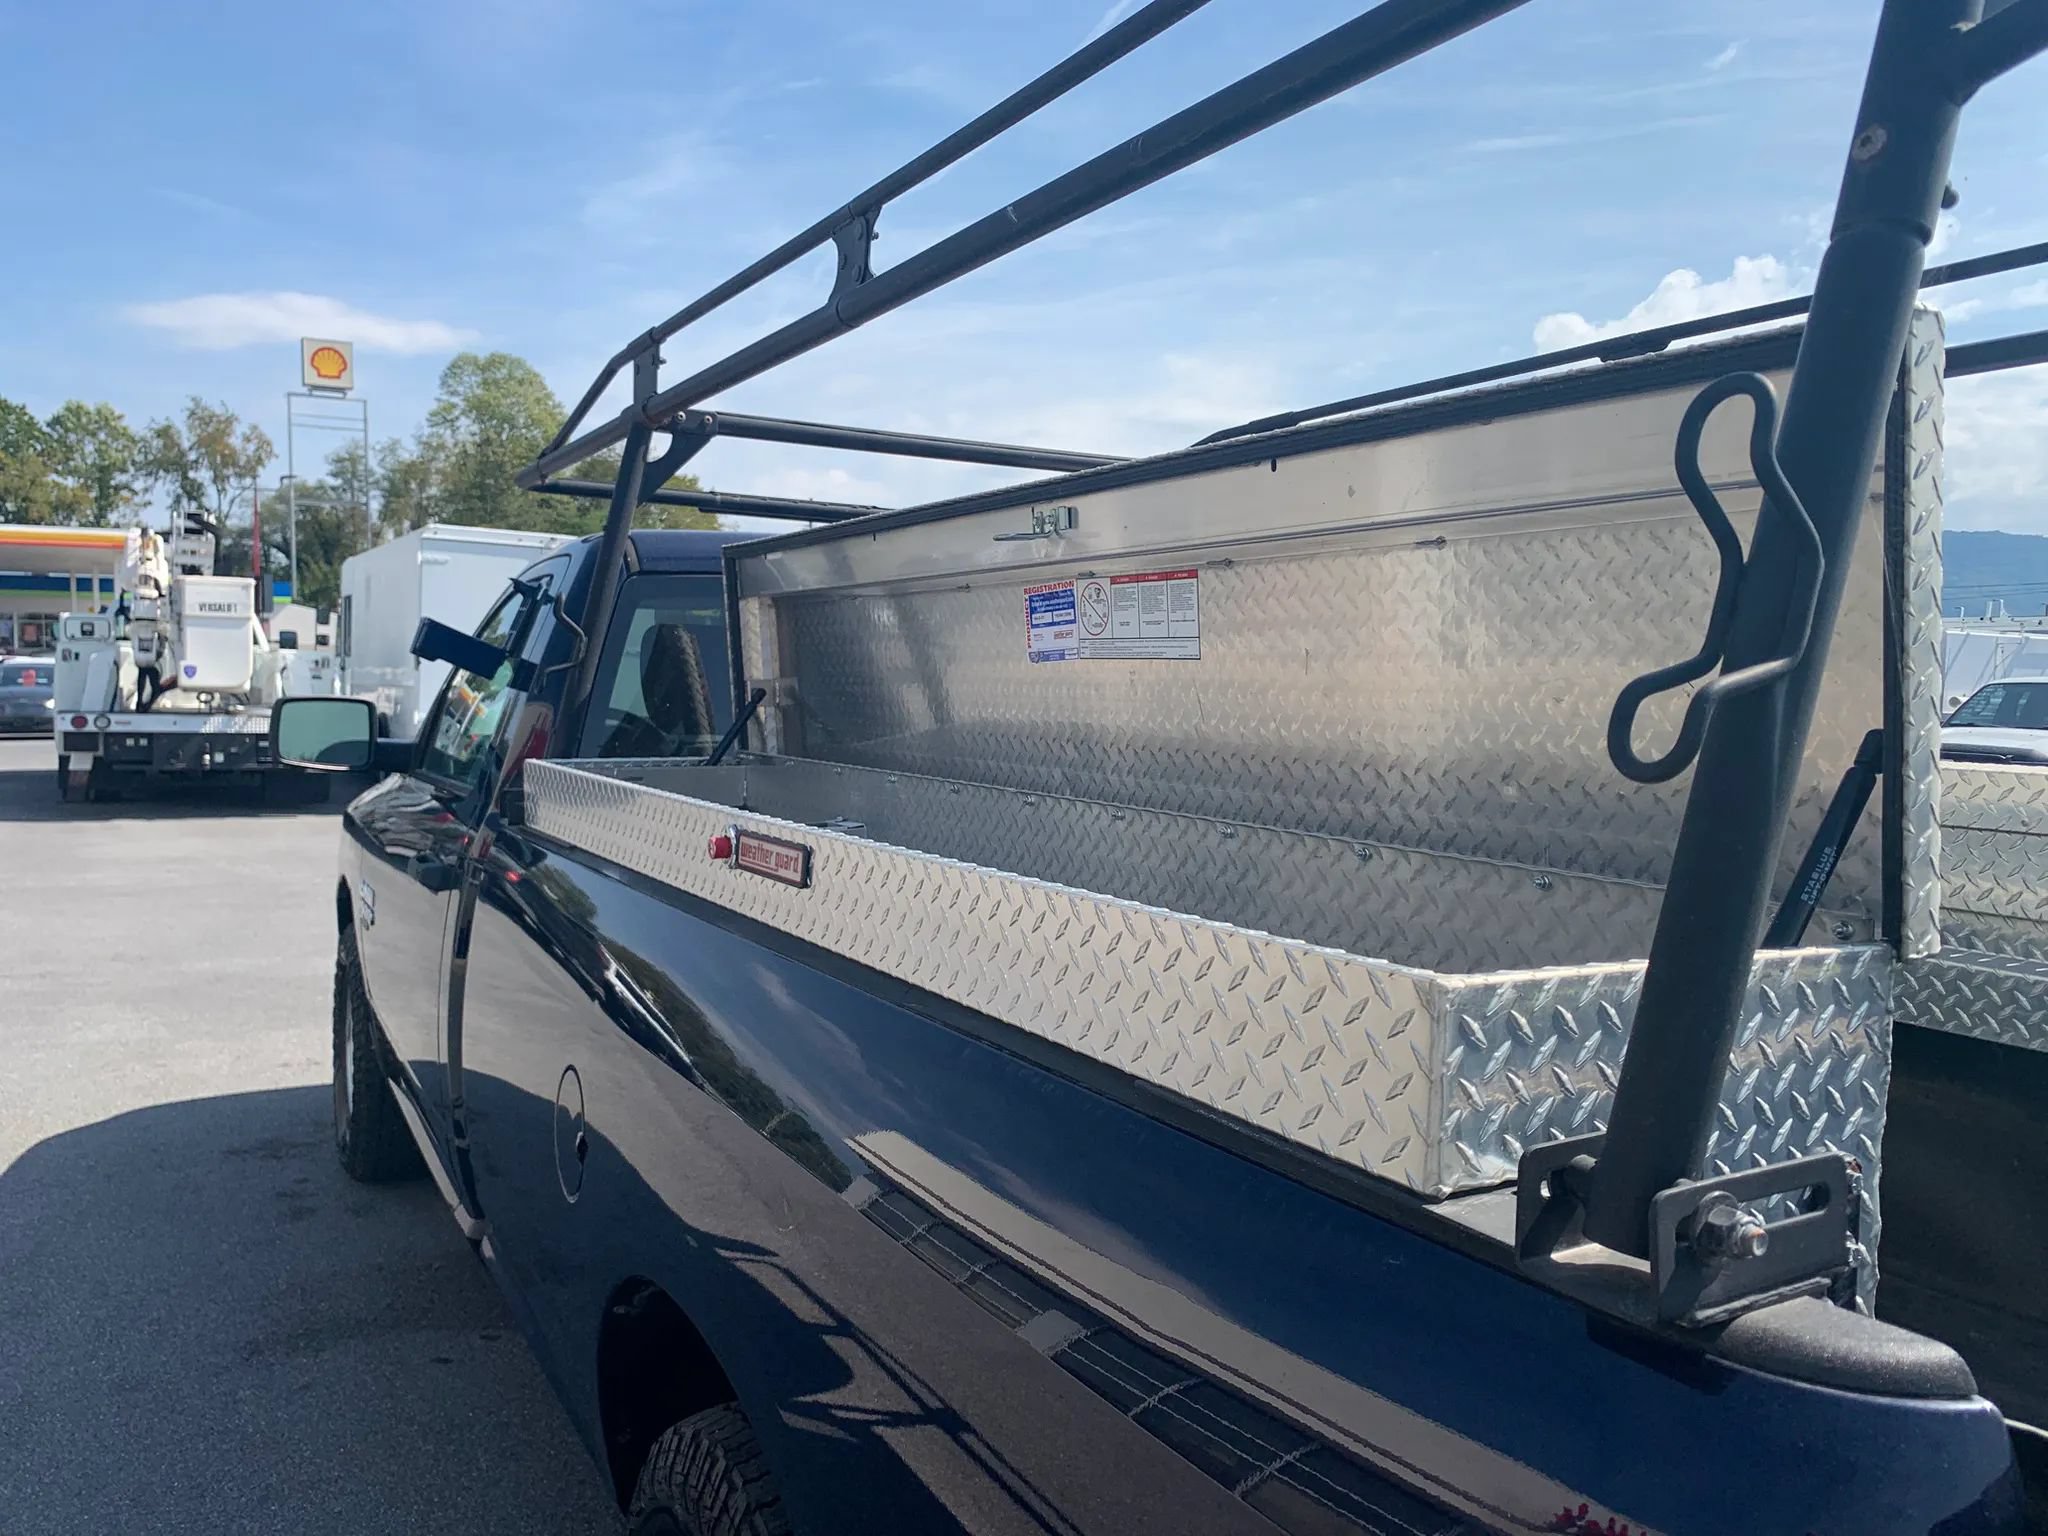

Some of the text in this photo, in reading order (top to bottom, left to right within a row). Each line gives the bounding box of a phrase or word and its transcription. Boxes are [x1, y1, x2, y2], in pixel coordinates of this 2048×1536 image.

[1023, 581, 1075, 596] REGISTRATION
[1024, 596, 1032, 649] PRODUCT
[740, 841, 800, 874] weather guard
[1800, 846, 1832, 901] STABILUS
